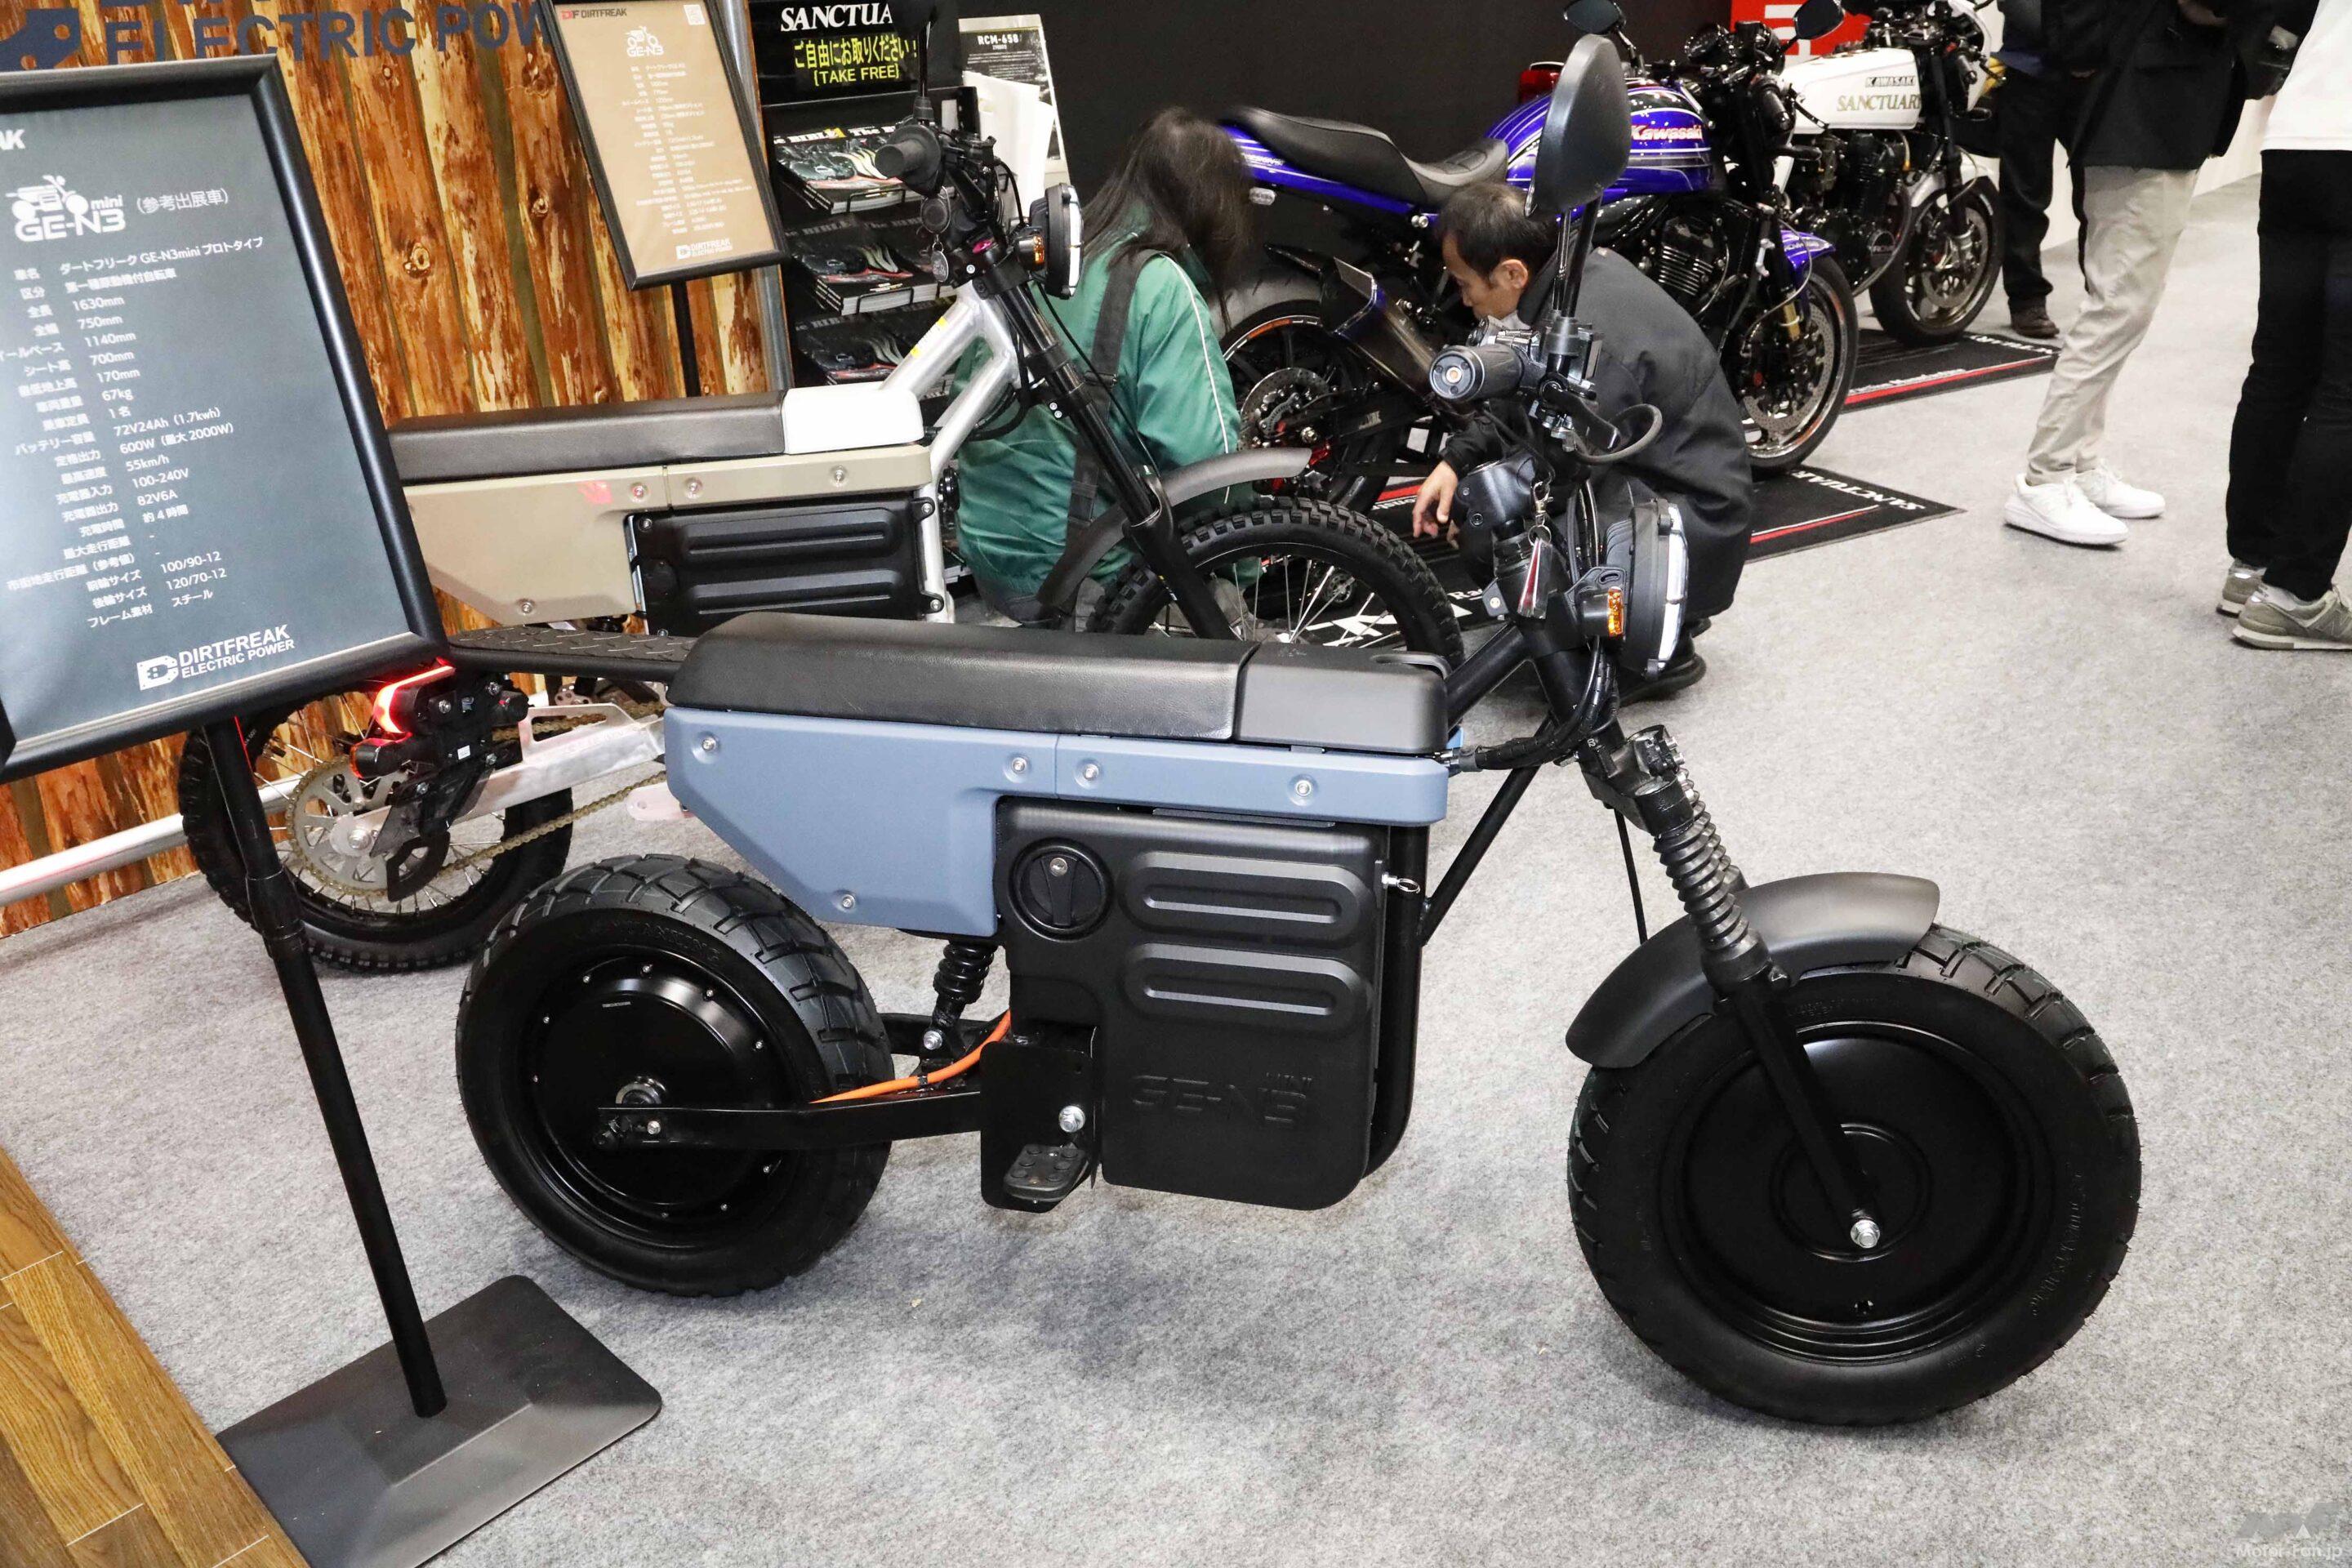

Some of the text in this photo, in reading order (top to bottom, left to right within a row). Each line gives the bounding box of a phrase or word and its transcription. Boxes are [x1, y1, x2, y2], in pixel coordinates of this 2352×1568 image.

[581, 8, 627, 19] DIRTFREAK
[978, 33, 1019, 45] RCM-658
[1865, 76, 1915, 87] KAWASAKI
[1631, 124, 1703, 140] Kawasaki
[91, 195, 122, 210] mini
[15, 209, 126, 242] GE-N3
[60, 255, 137, 275] ダートフリーク
[140, 245, 200, 264] GE-N3mini
[204, 236, 263, 255] プロトタイプ
[73, 296, 124, 311] 1630mm
[77, 314, 122, 330] 750mm
[85, 331, 136, 347] 1140mm
[90, 350, 135, 366] 700mm
[97, 368, 140, 384] 170mm
[101, 388, 134, 402] 67kg
[125, 454, 170, 472] 55km/h
[132, 468, 189, 489] 100-240V
[137, 489, 178, 506] 82V6A
[161, 551, 222, 573] 100/90-12
[166, 568, 227, 590] 120/70-12
[172, 590, 213, 608] スチール
[179, 624, 290, 667] DIRTFREAK
[181, 639, 295, 679] ELECTRIC POWER
